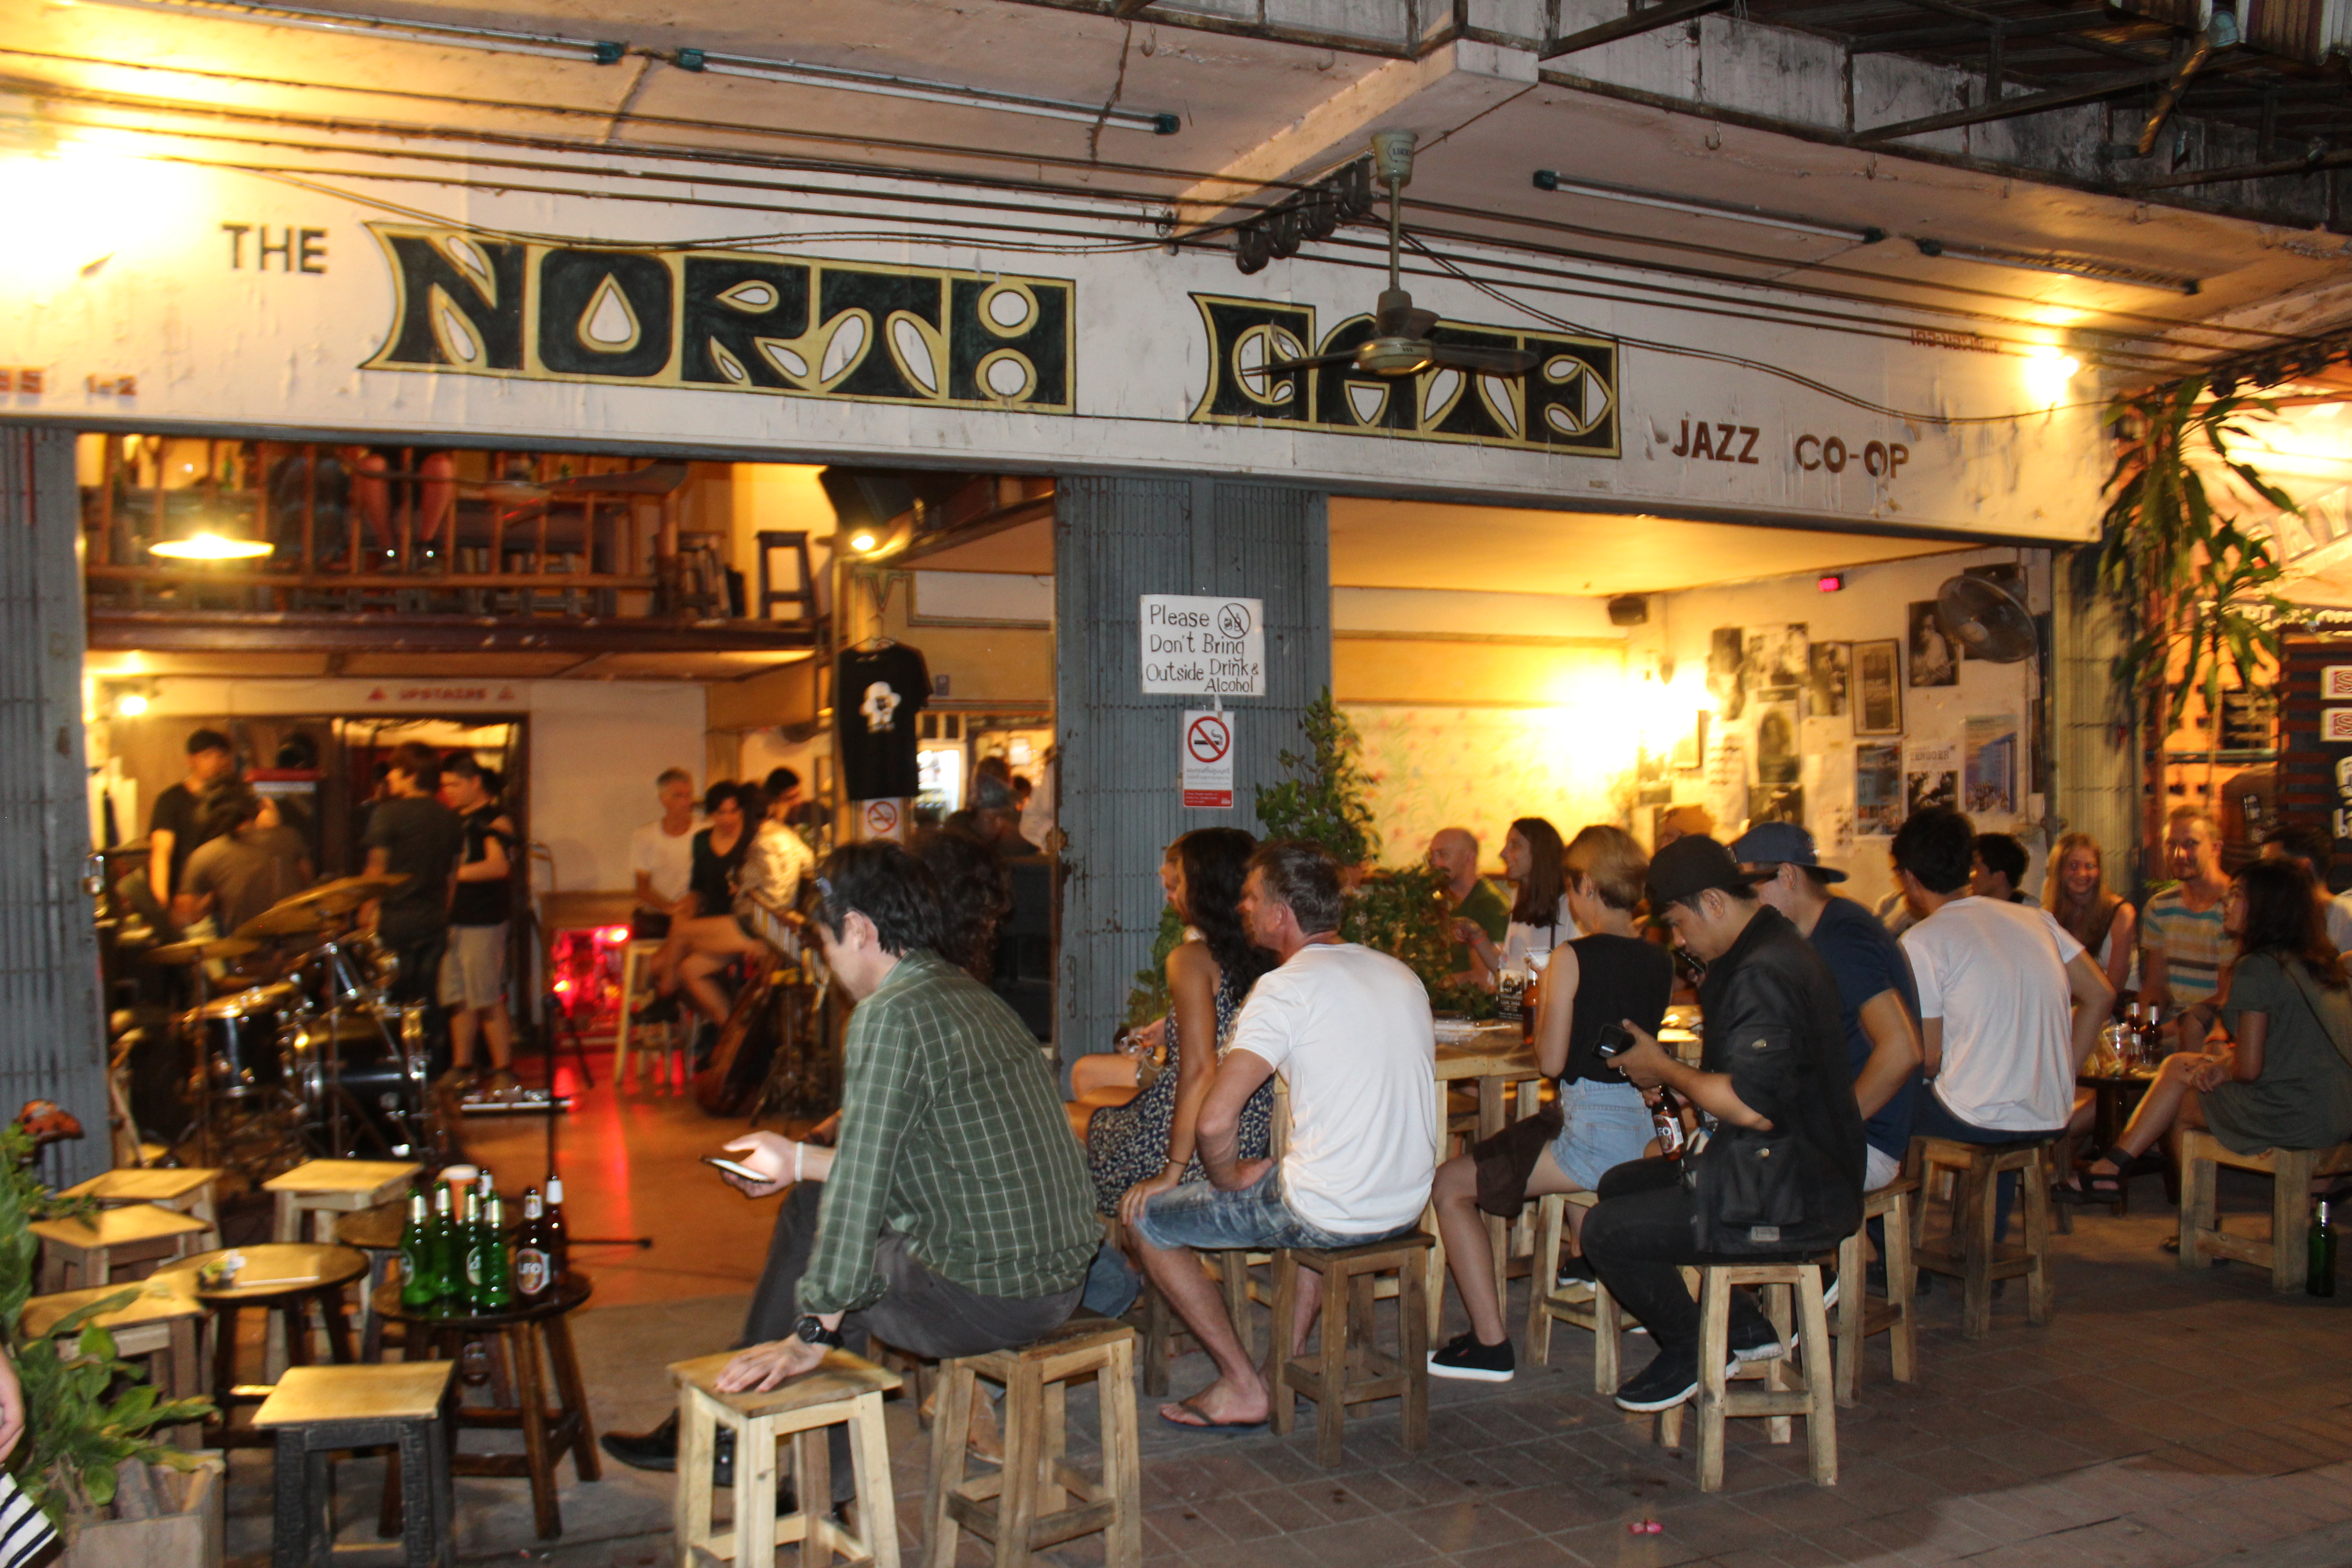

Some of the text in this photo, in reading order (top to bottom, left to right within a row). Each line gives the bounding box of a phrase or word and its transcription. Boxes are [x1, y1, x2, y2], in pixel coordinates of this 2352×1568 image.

[221, 223, 327, 274] THE
[358, 221, 1076, 416] NORTH
[1672, 419, 1910, 479] JAZZ CO-OP
[1150, 603, 1210, 627] Please
[1150, 631, 1244, 661] Don't Bring
[1146, 658, 1259, 681] Outside Drink &
[1204, 675, 1254, 693] Alcohol
